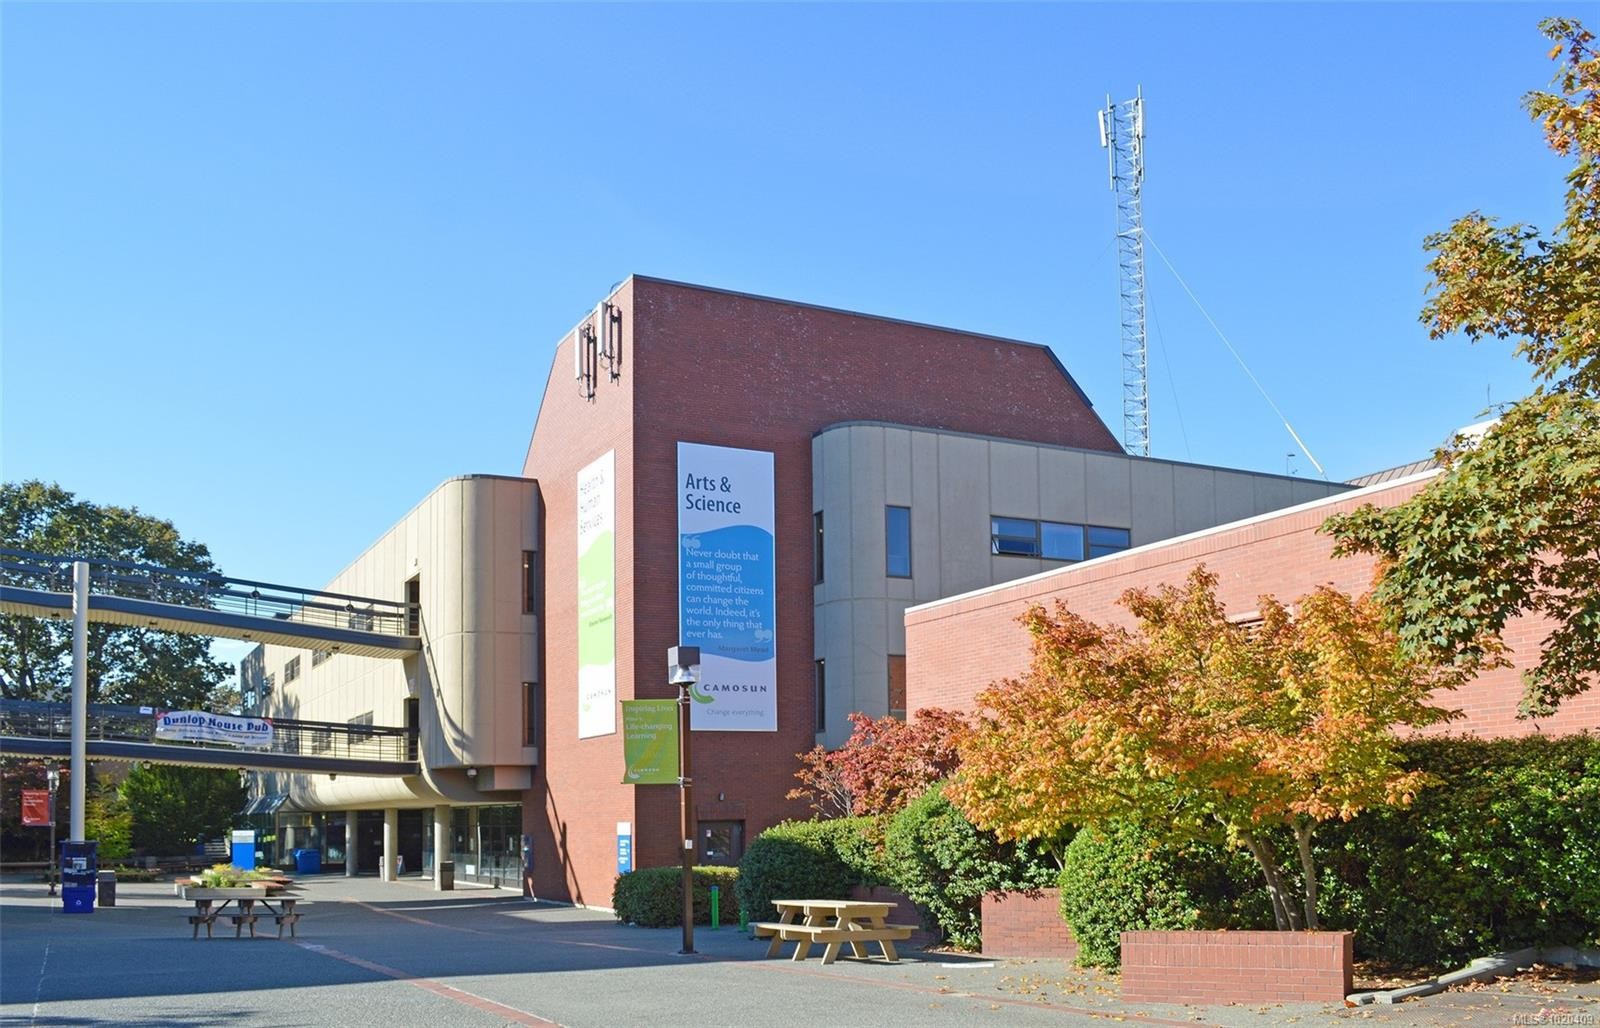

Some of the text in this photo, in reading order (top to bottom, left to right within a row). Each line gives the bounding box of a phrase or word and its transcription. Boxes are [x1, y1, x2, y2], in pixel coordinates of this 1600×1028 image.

[685, 473, 731, 493] Arts &
[685, 493, 742, 514] Science
[686, 548, 759, 561] Never doubt that
[693, 560, 715, 569] small
[716, 562, 743, 573] group
[686, 571, 743, 584] of thoughtful,
[686, 583, 764, 595] committed citizens
[703, 595, 733, 607] change
[735, 596, 750, 606] the
[686, 606, 712, 615] world.
[715, 607, 748, 618] Indeed,
[686, 617, 763, 631] the only thing that
[686, 630, 723, 639] ever has.
[703, 683, 768, 693] CAMOSUN
[707, 708, 730, 717] Change
[163, 714, 269, 732] Dunlop House Pub
